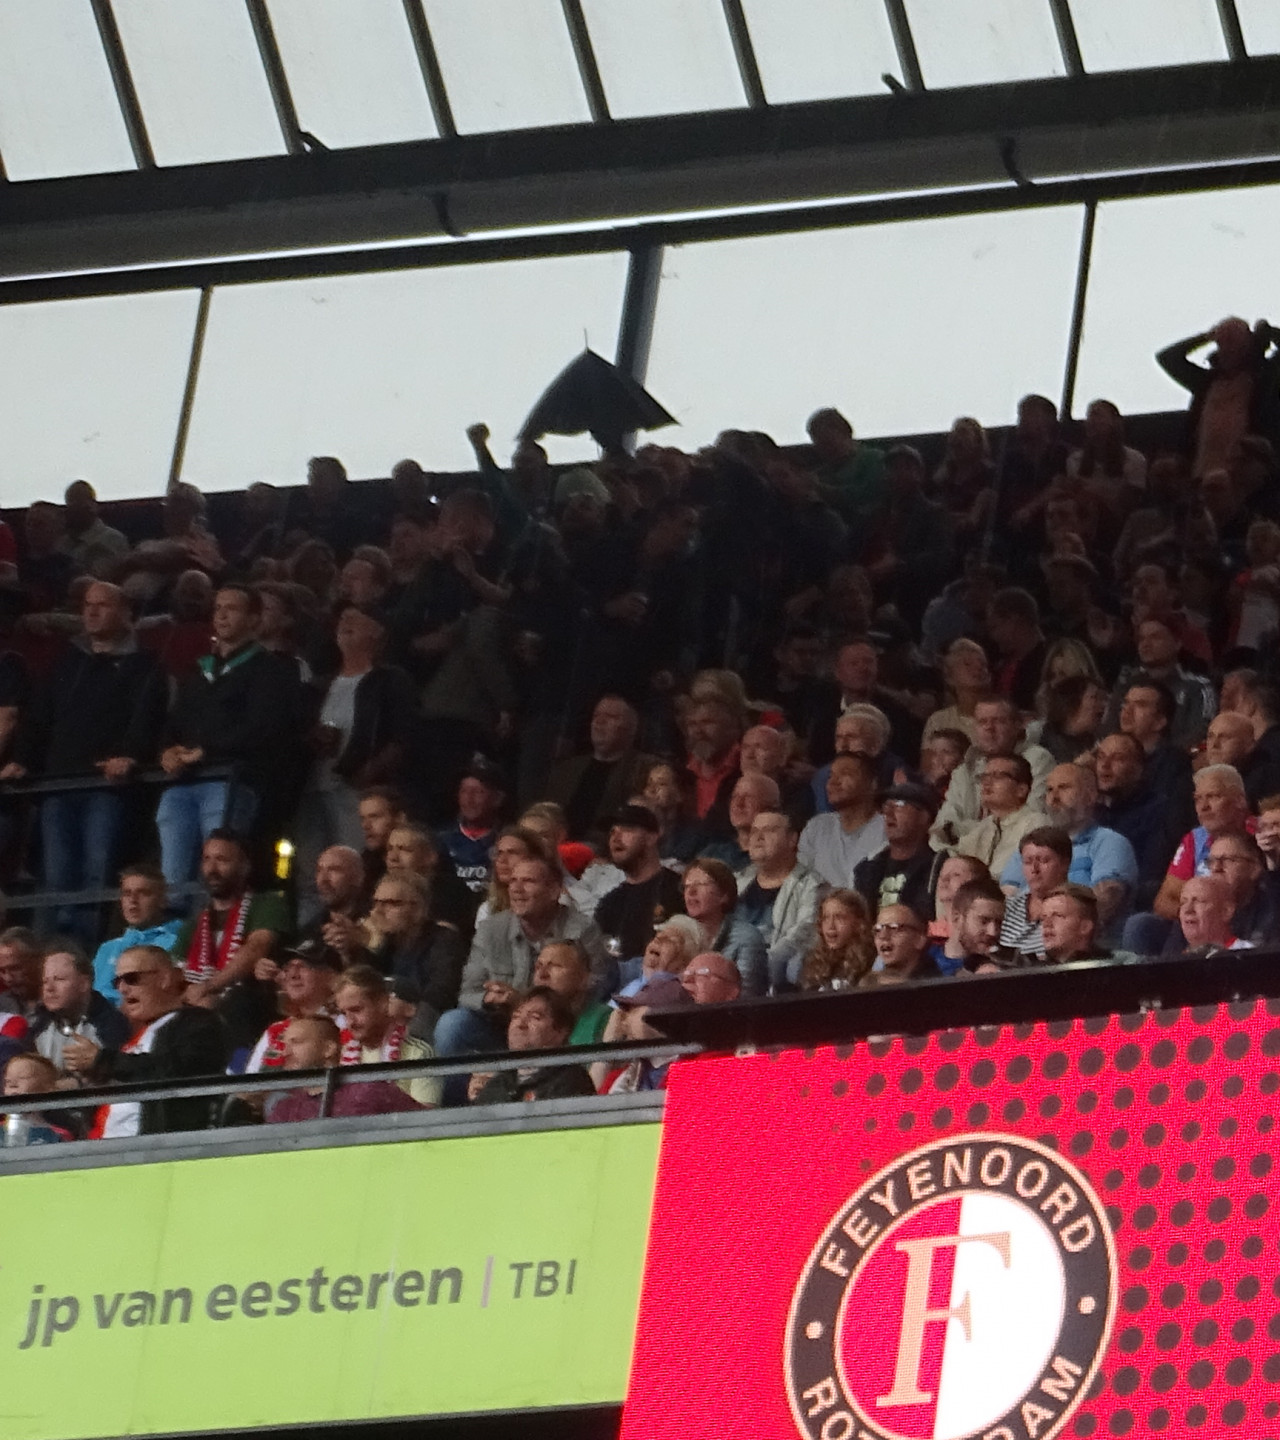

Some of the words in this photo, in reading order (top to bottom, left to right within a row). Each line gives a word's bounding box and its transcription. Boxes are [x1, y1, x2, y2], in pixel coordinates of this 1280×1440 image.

[819, 1146, 1097, 1278] FEYENOORD
[18, 1284, 80, 1350] jp
[93, 1285, 194, 1330] van
[204, 1265, 463, 1322] eesteren
[508, 1258, 577, 1299] TBI
